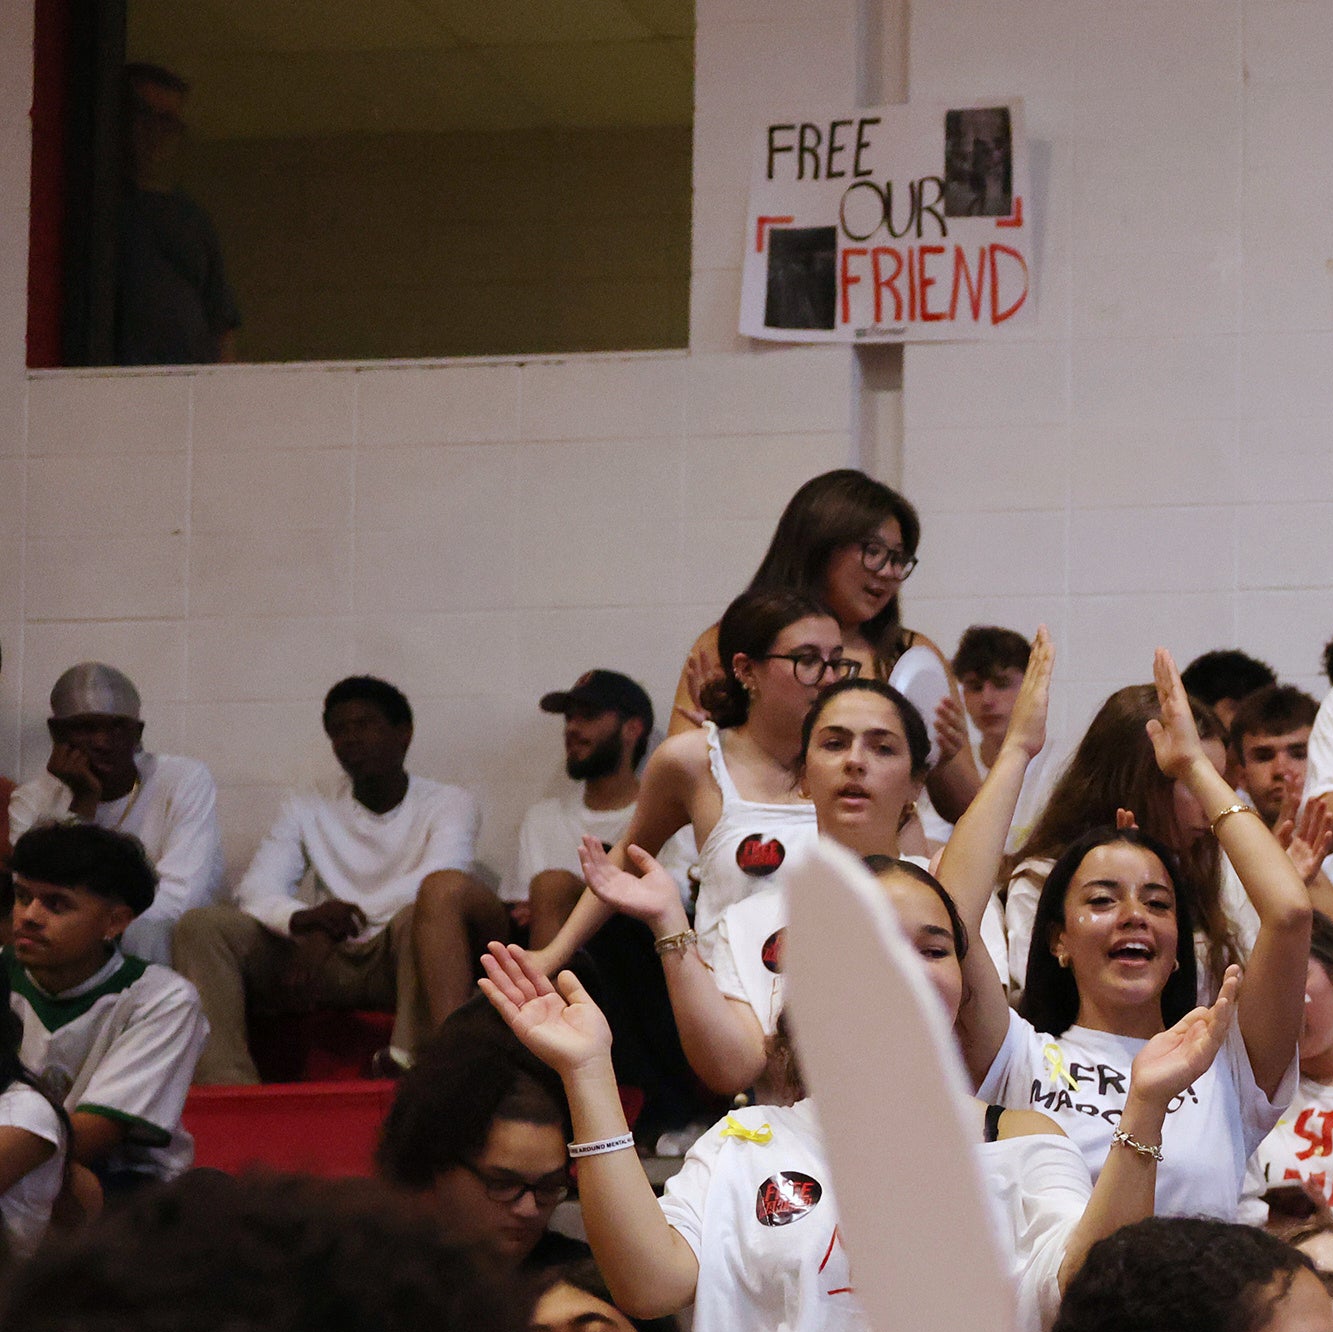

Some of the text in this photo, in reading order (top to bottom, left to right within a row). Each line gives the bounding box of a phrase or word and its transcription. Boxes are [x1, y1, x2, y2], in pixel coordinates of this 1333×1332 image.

[766, 117, 881, 180] FREE
[839, 176, 948, 242] OUR
[841, 243, 1029, 326] FRIEND
[1068, 1062, 1127, 1096] FR
